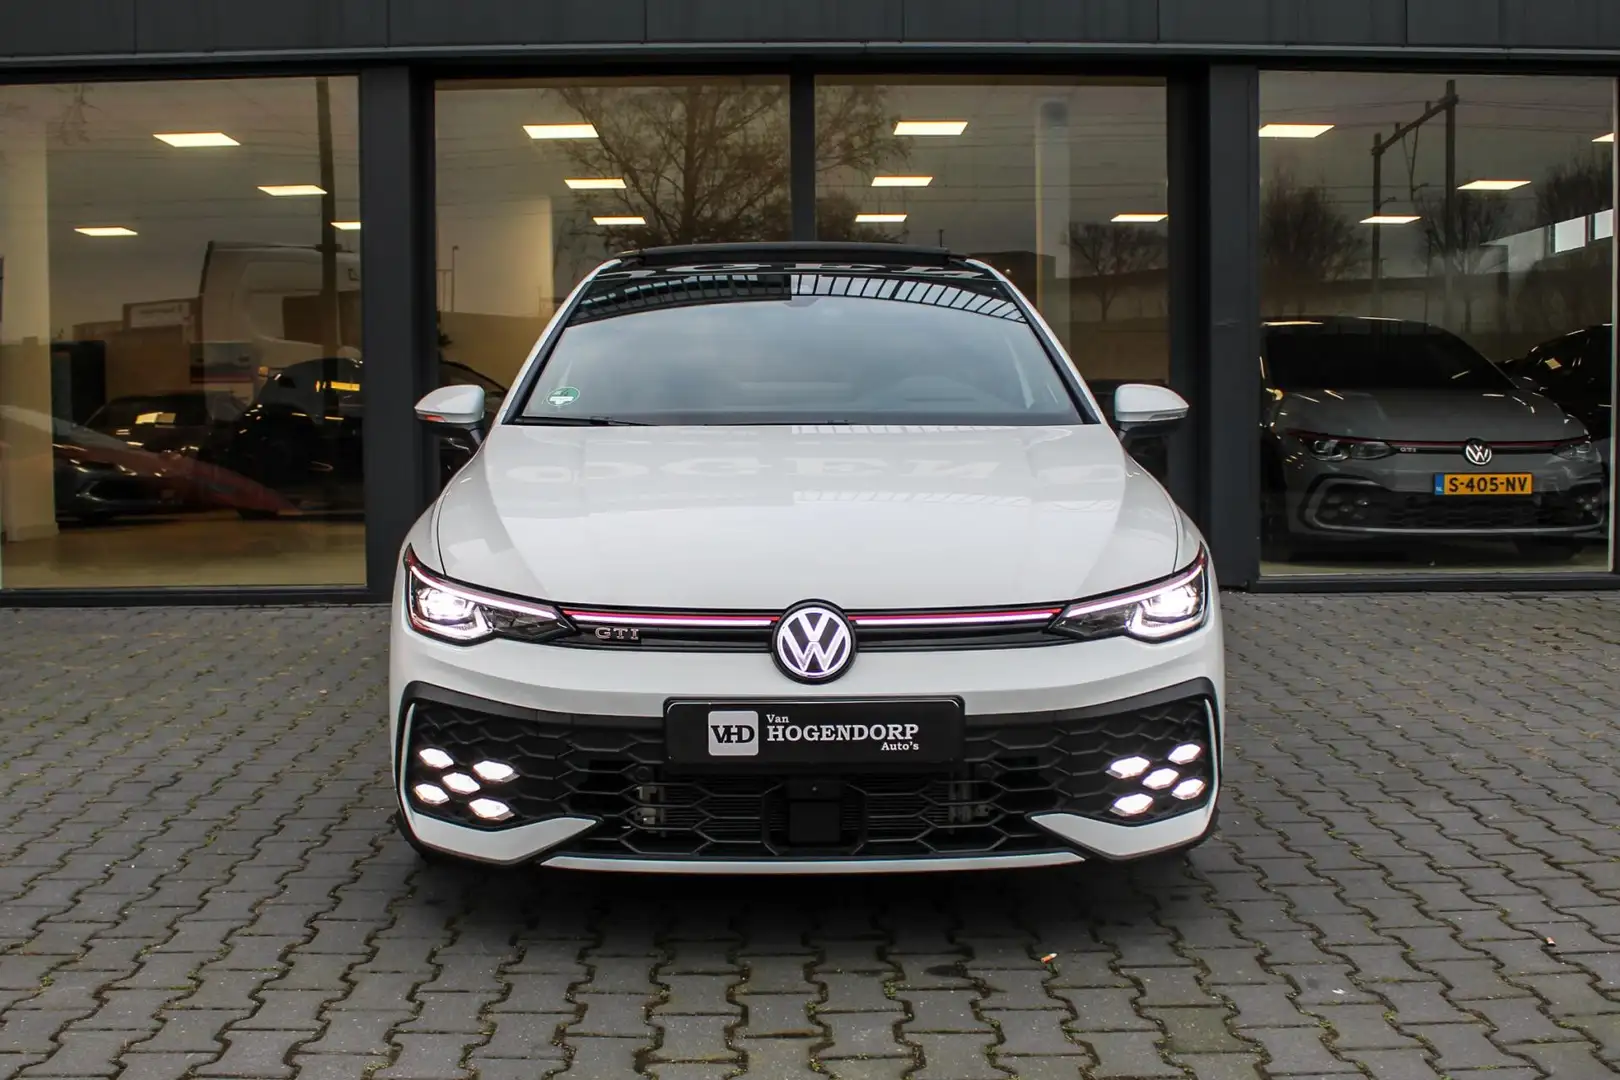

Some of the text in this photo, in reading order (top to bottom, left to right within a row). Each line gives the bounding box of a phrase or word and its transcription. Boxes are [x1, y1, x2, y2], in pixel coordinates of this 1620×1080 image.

[1449, 477, 1528, 493] S-405-NV
[595, 627, 639, 640] GTI
[777, 607, 852, 678] VW
[766, 714, 790, 723] Van
[711, 725, 756, 744] VHD
[767, 724, 920, 742] HOGENDORP
[881, 741, 920, 751] Auto's
